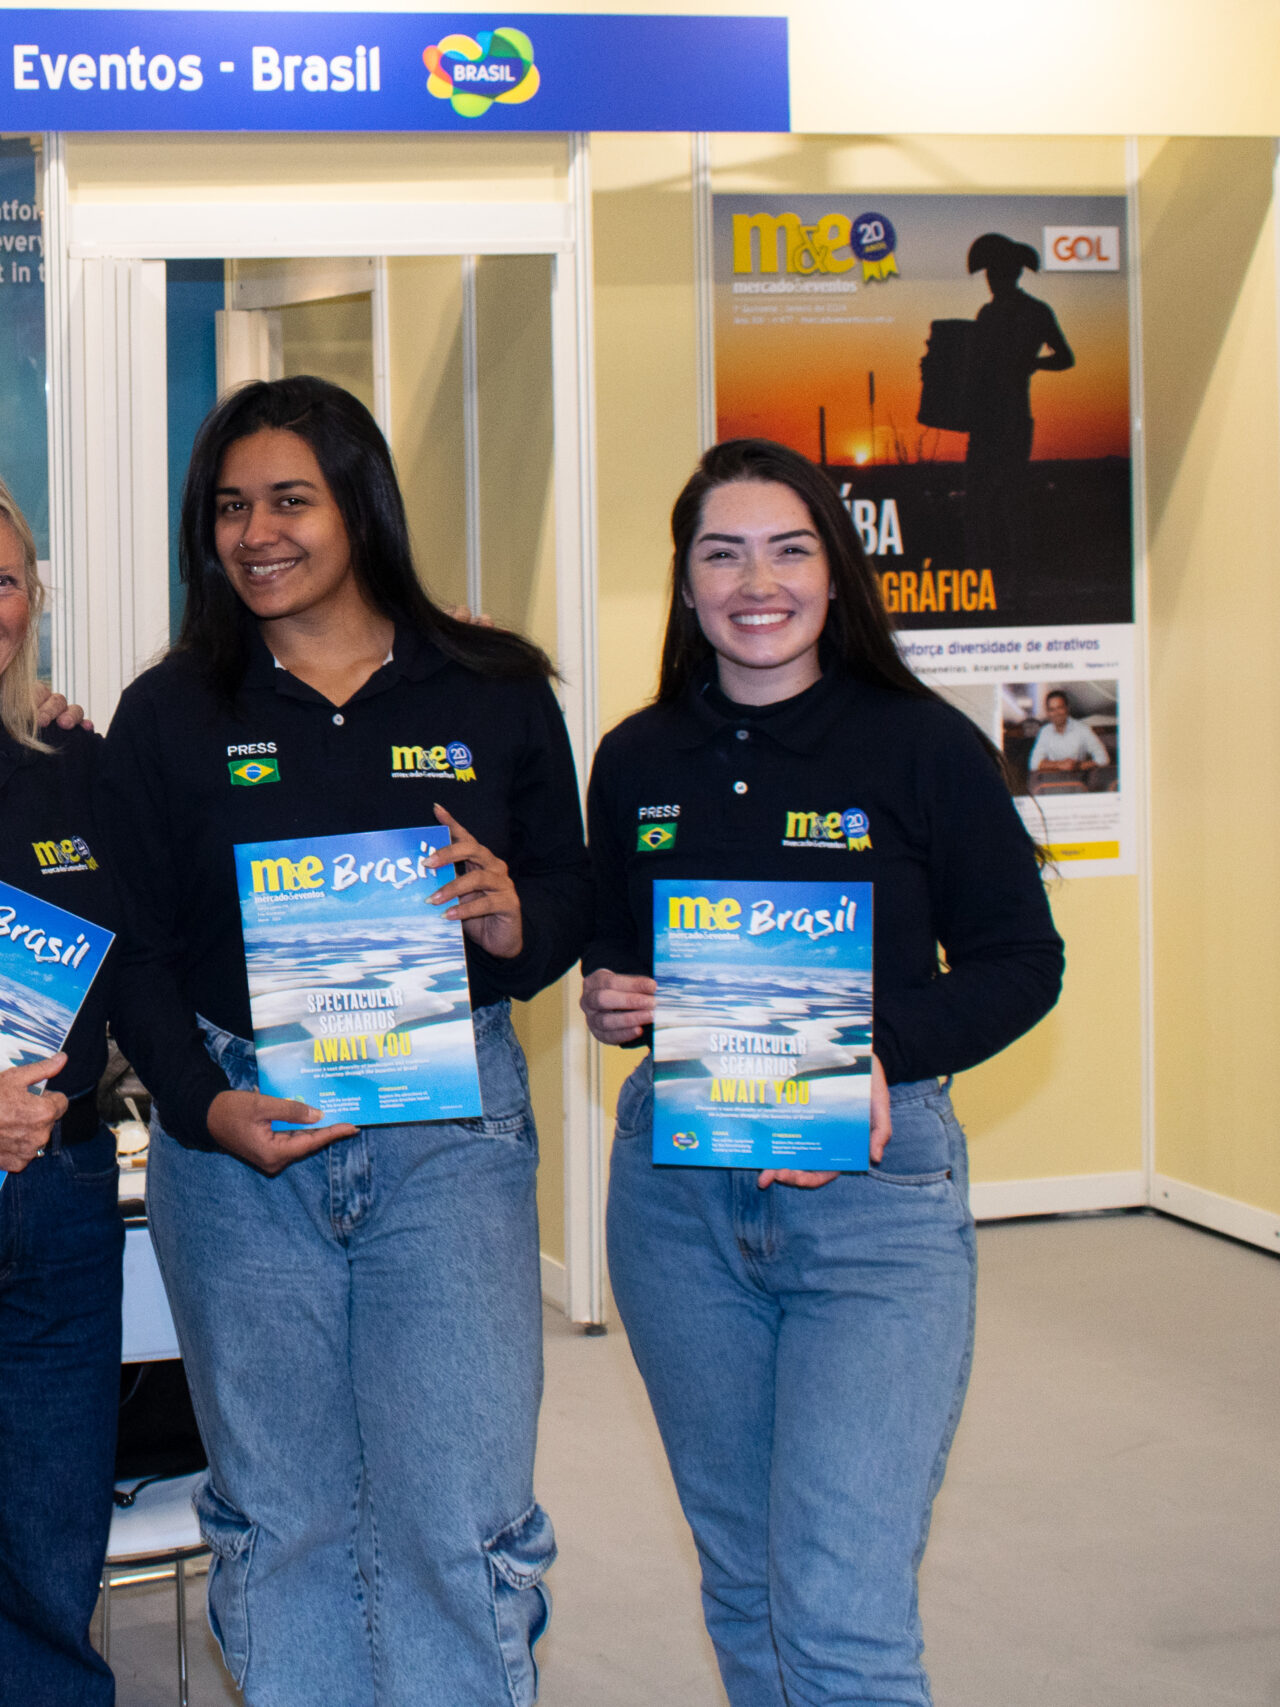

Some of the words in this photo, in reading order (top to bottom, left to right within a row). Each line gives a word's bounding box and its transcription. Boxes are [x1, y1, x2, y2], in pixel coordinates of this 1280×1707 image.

[12, 44, 203, 92] Eventos
[252, 45, 381, 92] Brasil
[453, 64, 517, 83] BRASIL
[858, 221, 886, 244] 20
[1053, 235, 1110, 262] GOL
[12, 261, 31, 283] in
[877, 557, 997, 614] GRÁFICA
[901, 642, 944, 658] eforça
[948, 640, 1021, 655] diversidade
[1026, 639, 1042, 652] de
[1047, 638, 1100, 652] atrativos
[227, 742, 277, 756] PRESS
[451, 747, 467, 760] 20
[638, 805, 680, 820] PRESS
[846, 813, 864, 828] 20
[254, 890, 326, 904] mercado&eventos
[747, 895, 858, 941] Brasil
[307, 988, 404, 1014] SPECTACULAR
[319, 1010, 396, 1034] SCENARIOS
[313, 1035, 368, 1064] AWAIT
[375, 1031, 412, 1058] YOU
[709, 1033, 808, 1056] SPECTACULAR
[719, 1056, 798, 1078] SCENARIOS
[709, 1078, 767, 1105] AWAIT
[773, 1079, 810, 1106] YOU
